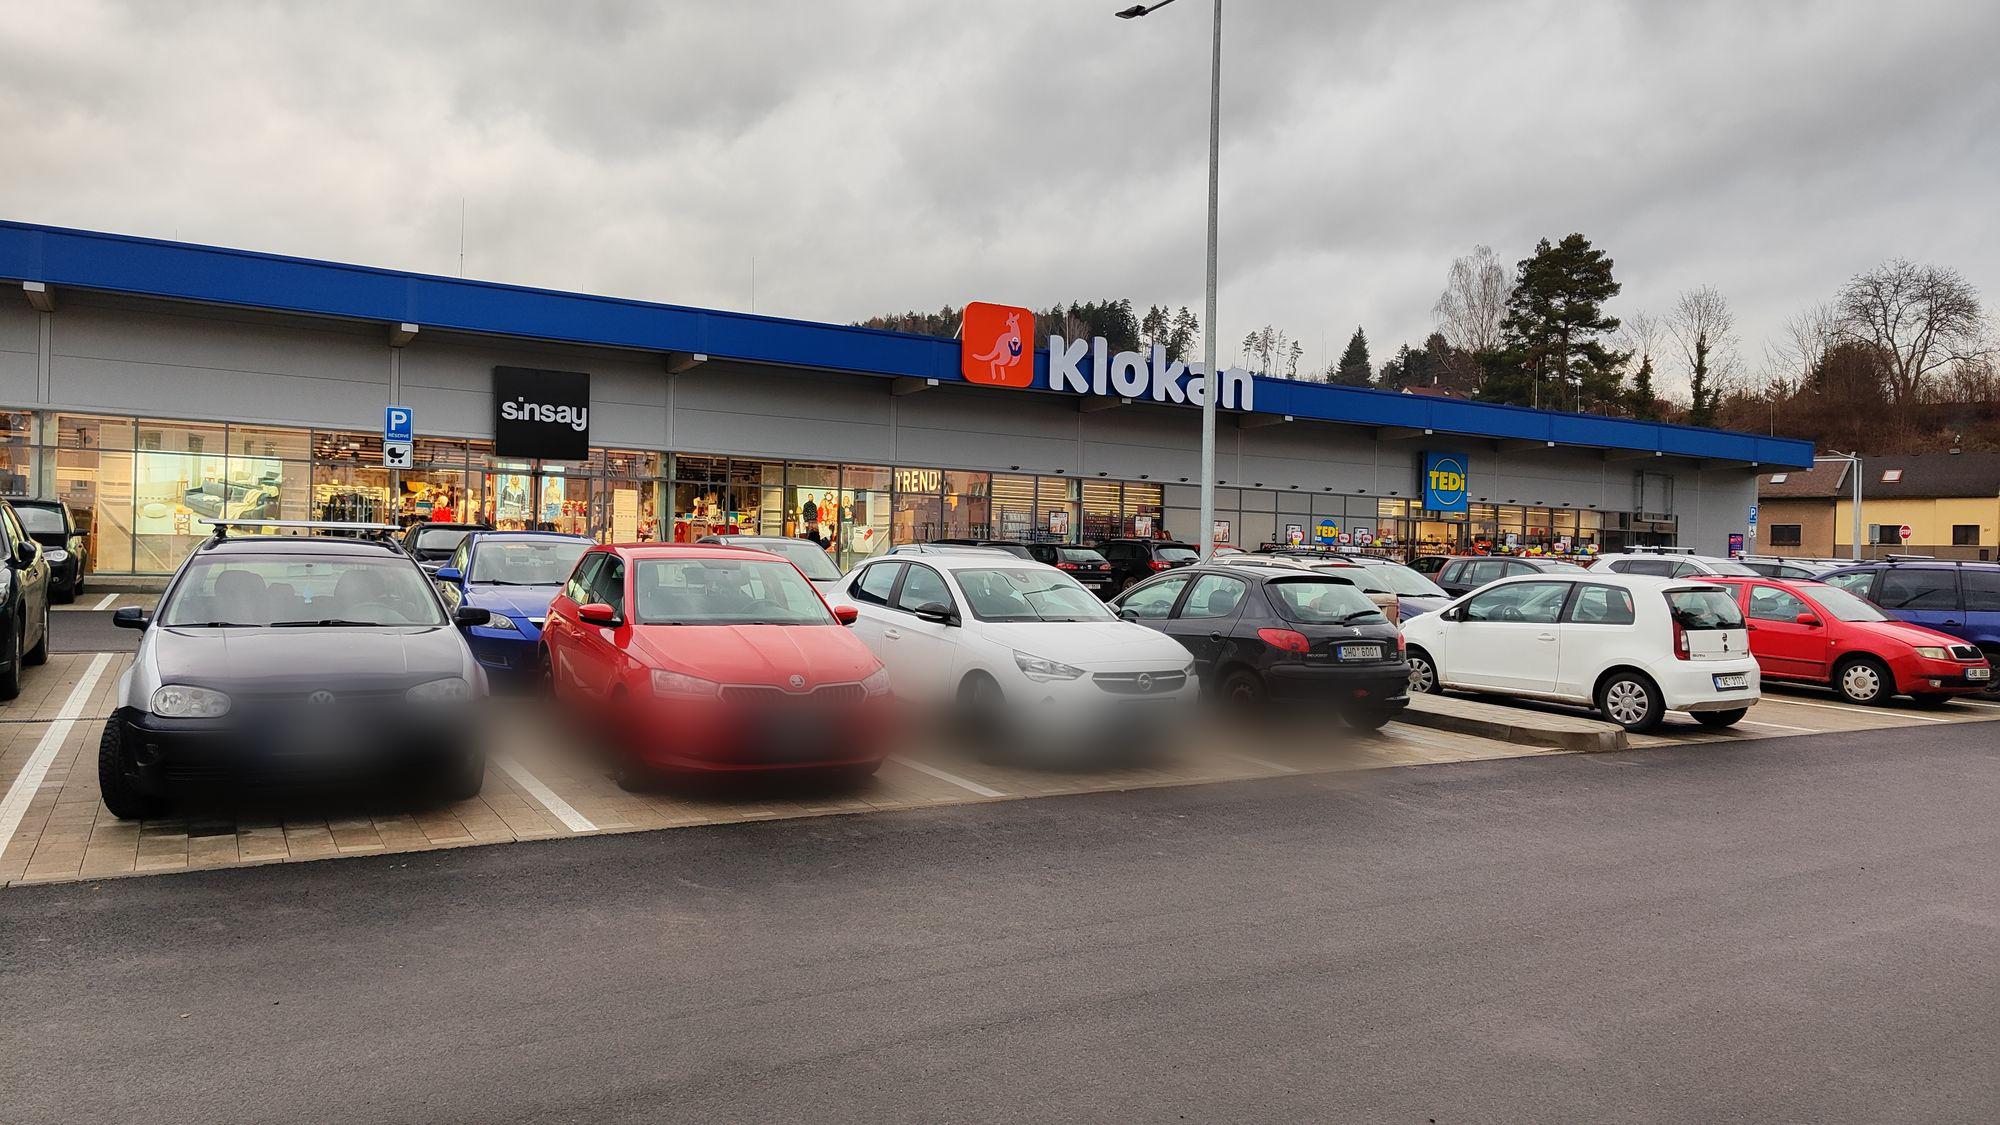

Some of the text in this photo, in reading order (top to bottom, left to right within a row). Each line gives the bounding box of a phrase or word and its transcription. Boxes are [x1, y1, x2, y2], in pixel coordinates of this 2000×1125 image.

[1049, 334, 1254, 411] Klokan
[391, 410, 407, 430] P
[501, 396, 587, 431] sinsay
[1429, 470, 1465, 491] TEDi
[1316, 525, 1339, 538] TEDi
